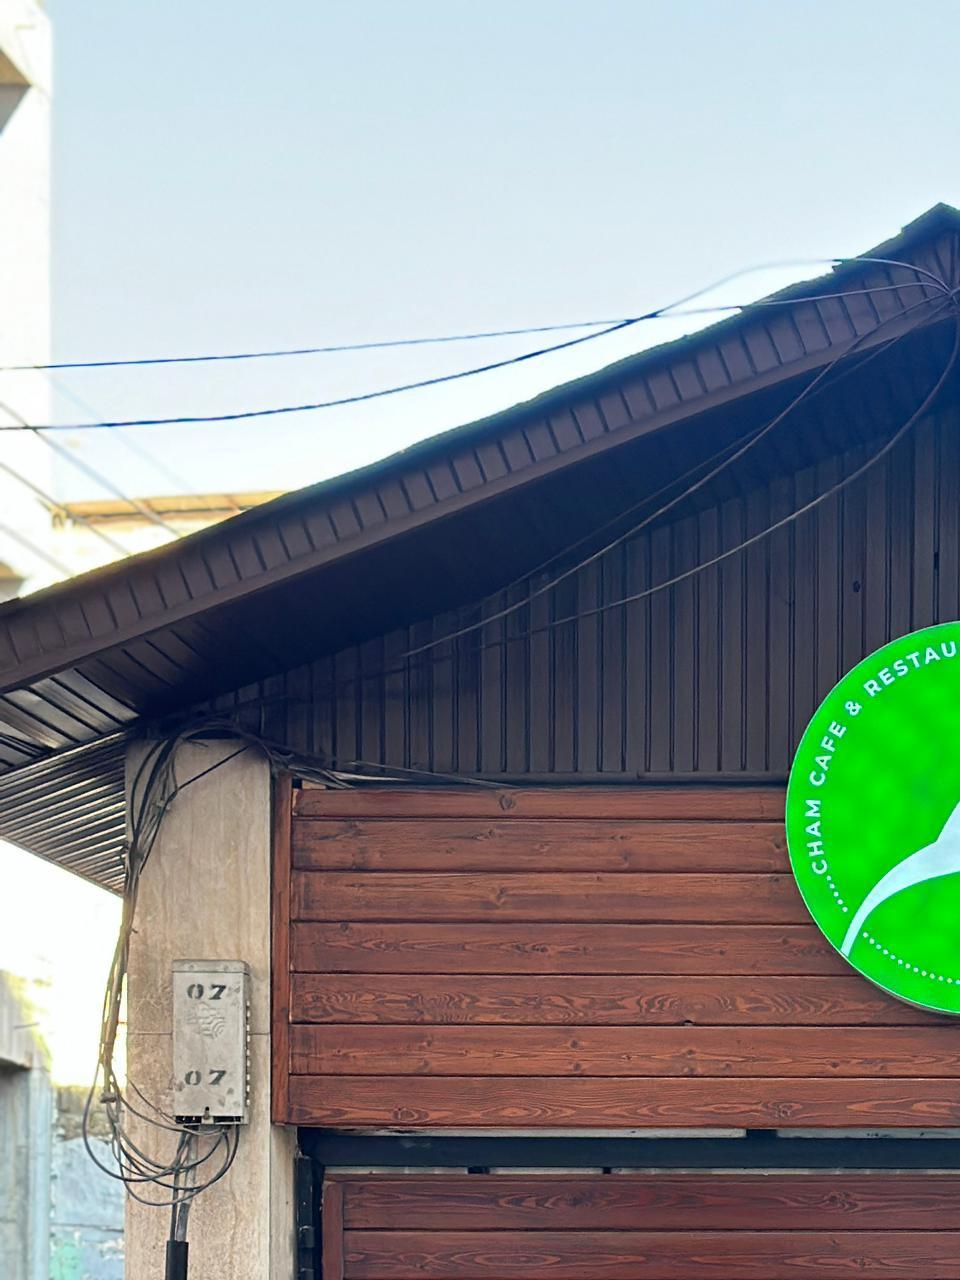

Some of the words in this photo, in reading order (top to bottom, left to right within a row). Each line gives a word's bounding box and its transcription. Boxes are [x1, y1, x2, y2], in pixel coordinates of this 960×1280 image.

[844, 700, 863, 716] &
[809, 721, 847, 787] CAFE
[804, 799, 829, 876] CHAM
[186, 983, 227, 1000] 07
[184, 1069, 227, 1086] 07
